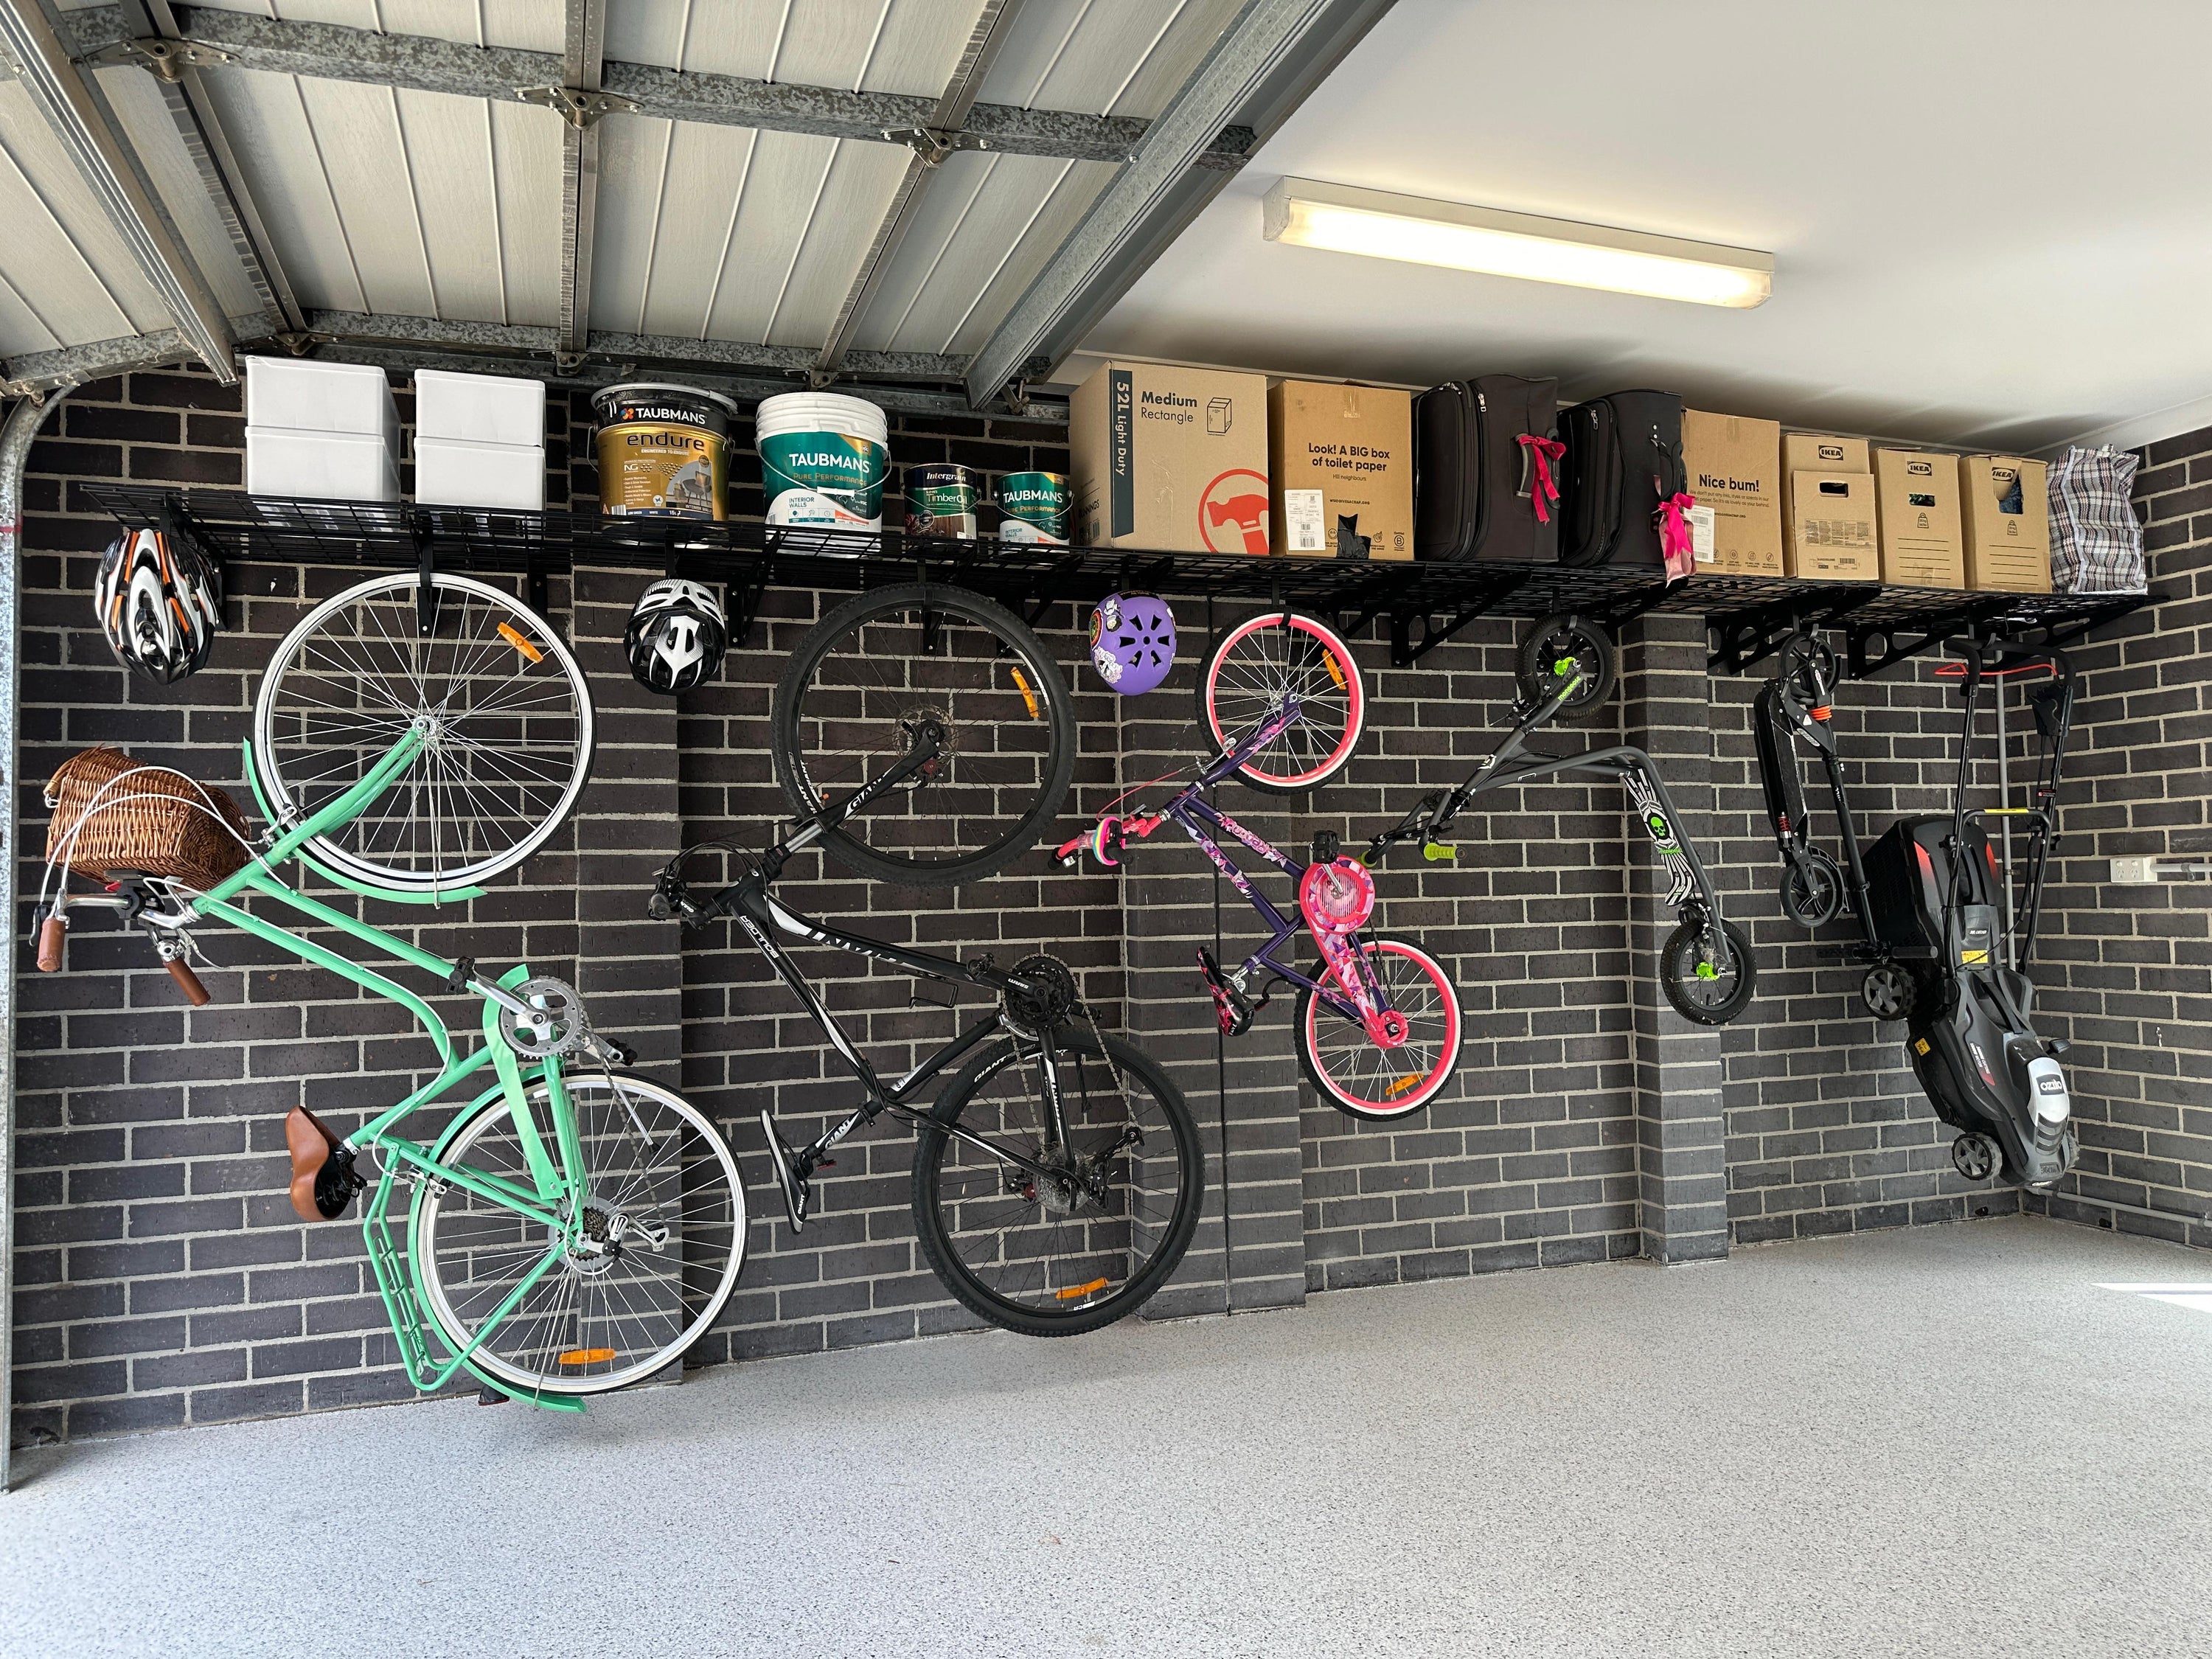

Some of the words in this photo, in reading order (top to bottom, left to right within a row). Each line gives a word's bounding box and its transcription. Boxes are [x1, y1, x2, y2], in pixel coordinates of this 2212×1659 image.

[1116, 381, 1130, 412] 52L
[1141, 391, 1197, 408] Medium
[636, 407, 706, 425] TAUBMANS
[1141, 407, 1194, 425] Rectangle
[1115, 414, 1127, 444] Light
[627, 432, 705, 451] endure
[1308, 442, 1337, 455] Look!
[1339, 445, 1347, 456] A
[1350, 446, 1368, 456] BIG
[1371, 448, 1390, 459] box
[789, 453, 870, 473] TAUBMANS
[1115, 448, 1127, 476] Duty
[1312, 456, 1323, 467] of
[1325, 458, 1353, 469] toilet
[1355, 461, 1387, 473] paper
[926, 472, 967, 482] Intergrain
[1699, 473, 1725, 488] Nice
[1729, 477, 1760, 493] bum!
[926, 493, 967, 505] TimberOil
[1003, 490, 1063, 504] TAUBMANS
[1557, 675, 1582, 701] mongoose
[740, 915, 780, 959] BOULDER
[973, 1055, 1007, 1083] GIANT
[2039, 1077, 2063, 1091] ozito
[824, 1118, 851, 1150] GIANT
[797, 1193, 805, 1215] GIANT
